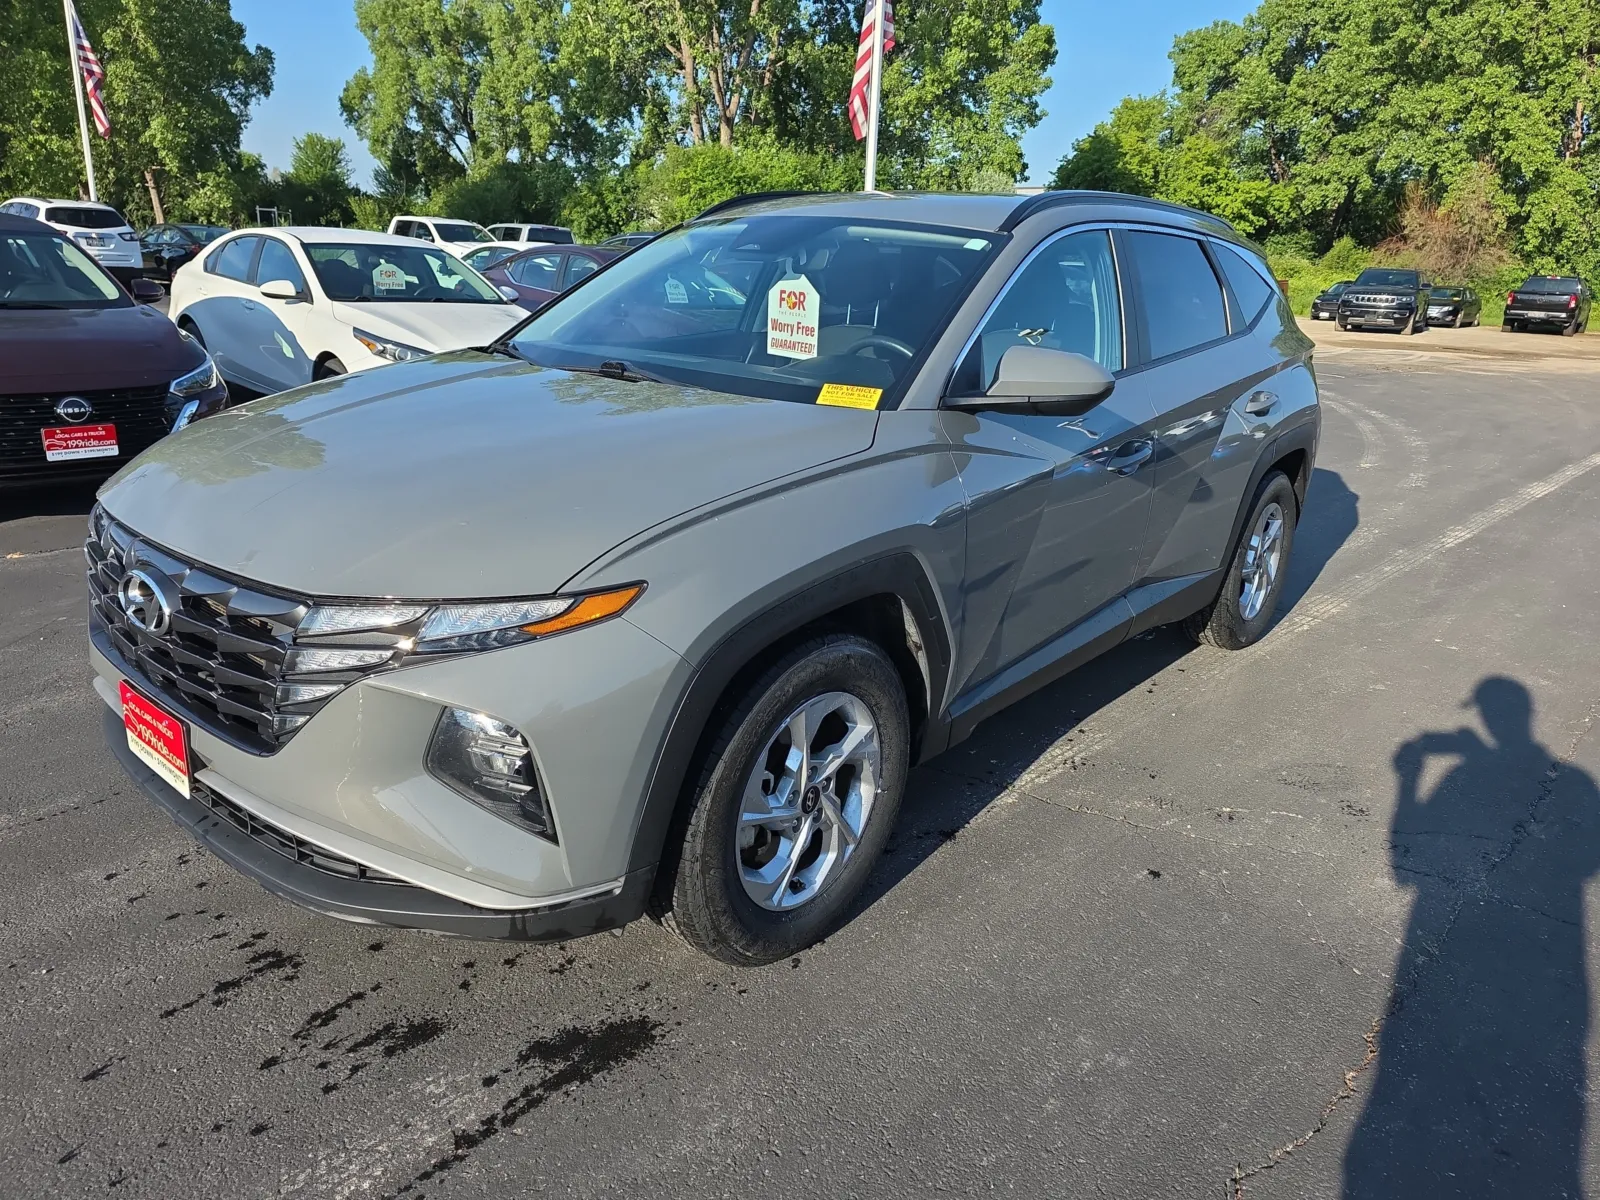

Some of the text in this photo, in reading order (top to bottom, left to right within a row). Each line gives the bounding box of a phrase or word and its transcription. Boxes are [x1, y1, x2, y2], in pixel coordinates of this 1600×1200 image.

[779, 289, 806, 311] FOR
[771, 318, 815, 337] Worry Free
[771, 338, 815, 354] GUARANTEED!
[846, 386, 878, 395] VEHICLE
